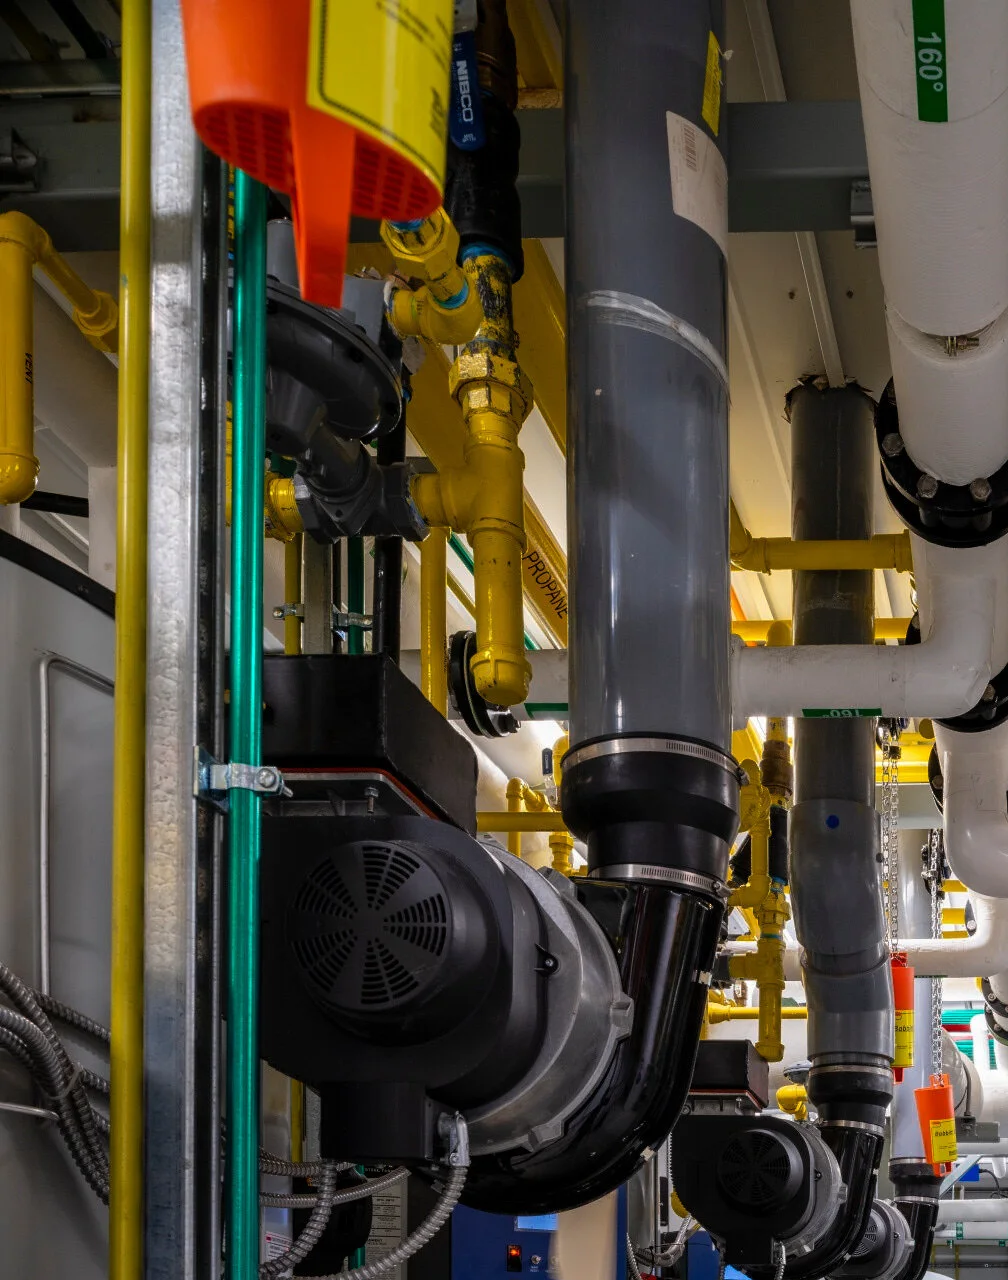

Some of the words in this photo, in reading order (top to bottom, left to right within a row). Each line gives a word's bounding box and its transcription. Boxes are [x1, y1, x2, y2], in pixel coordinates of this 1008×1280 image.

[455, 60, 474, 123] NIBCO
[917, 31, 945, 93] 160°
[521, 551, 569, 619] PROPANE
